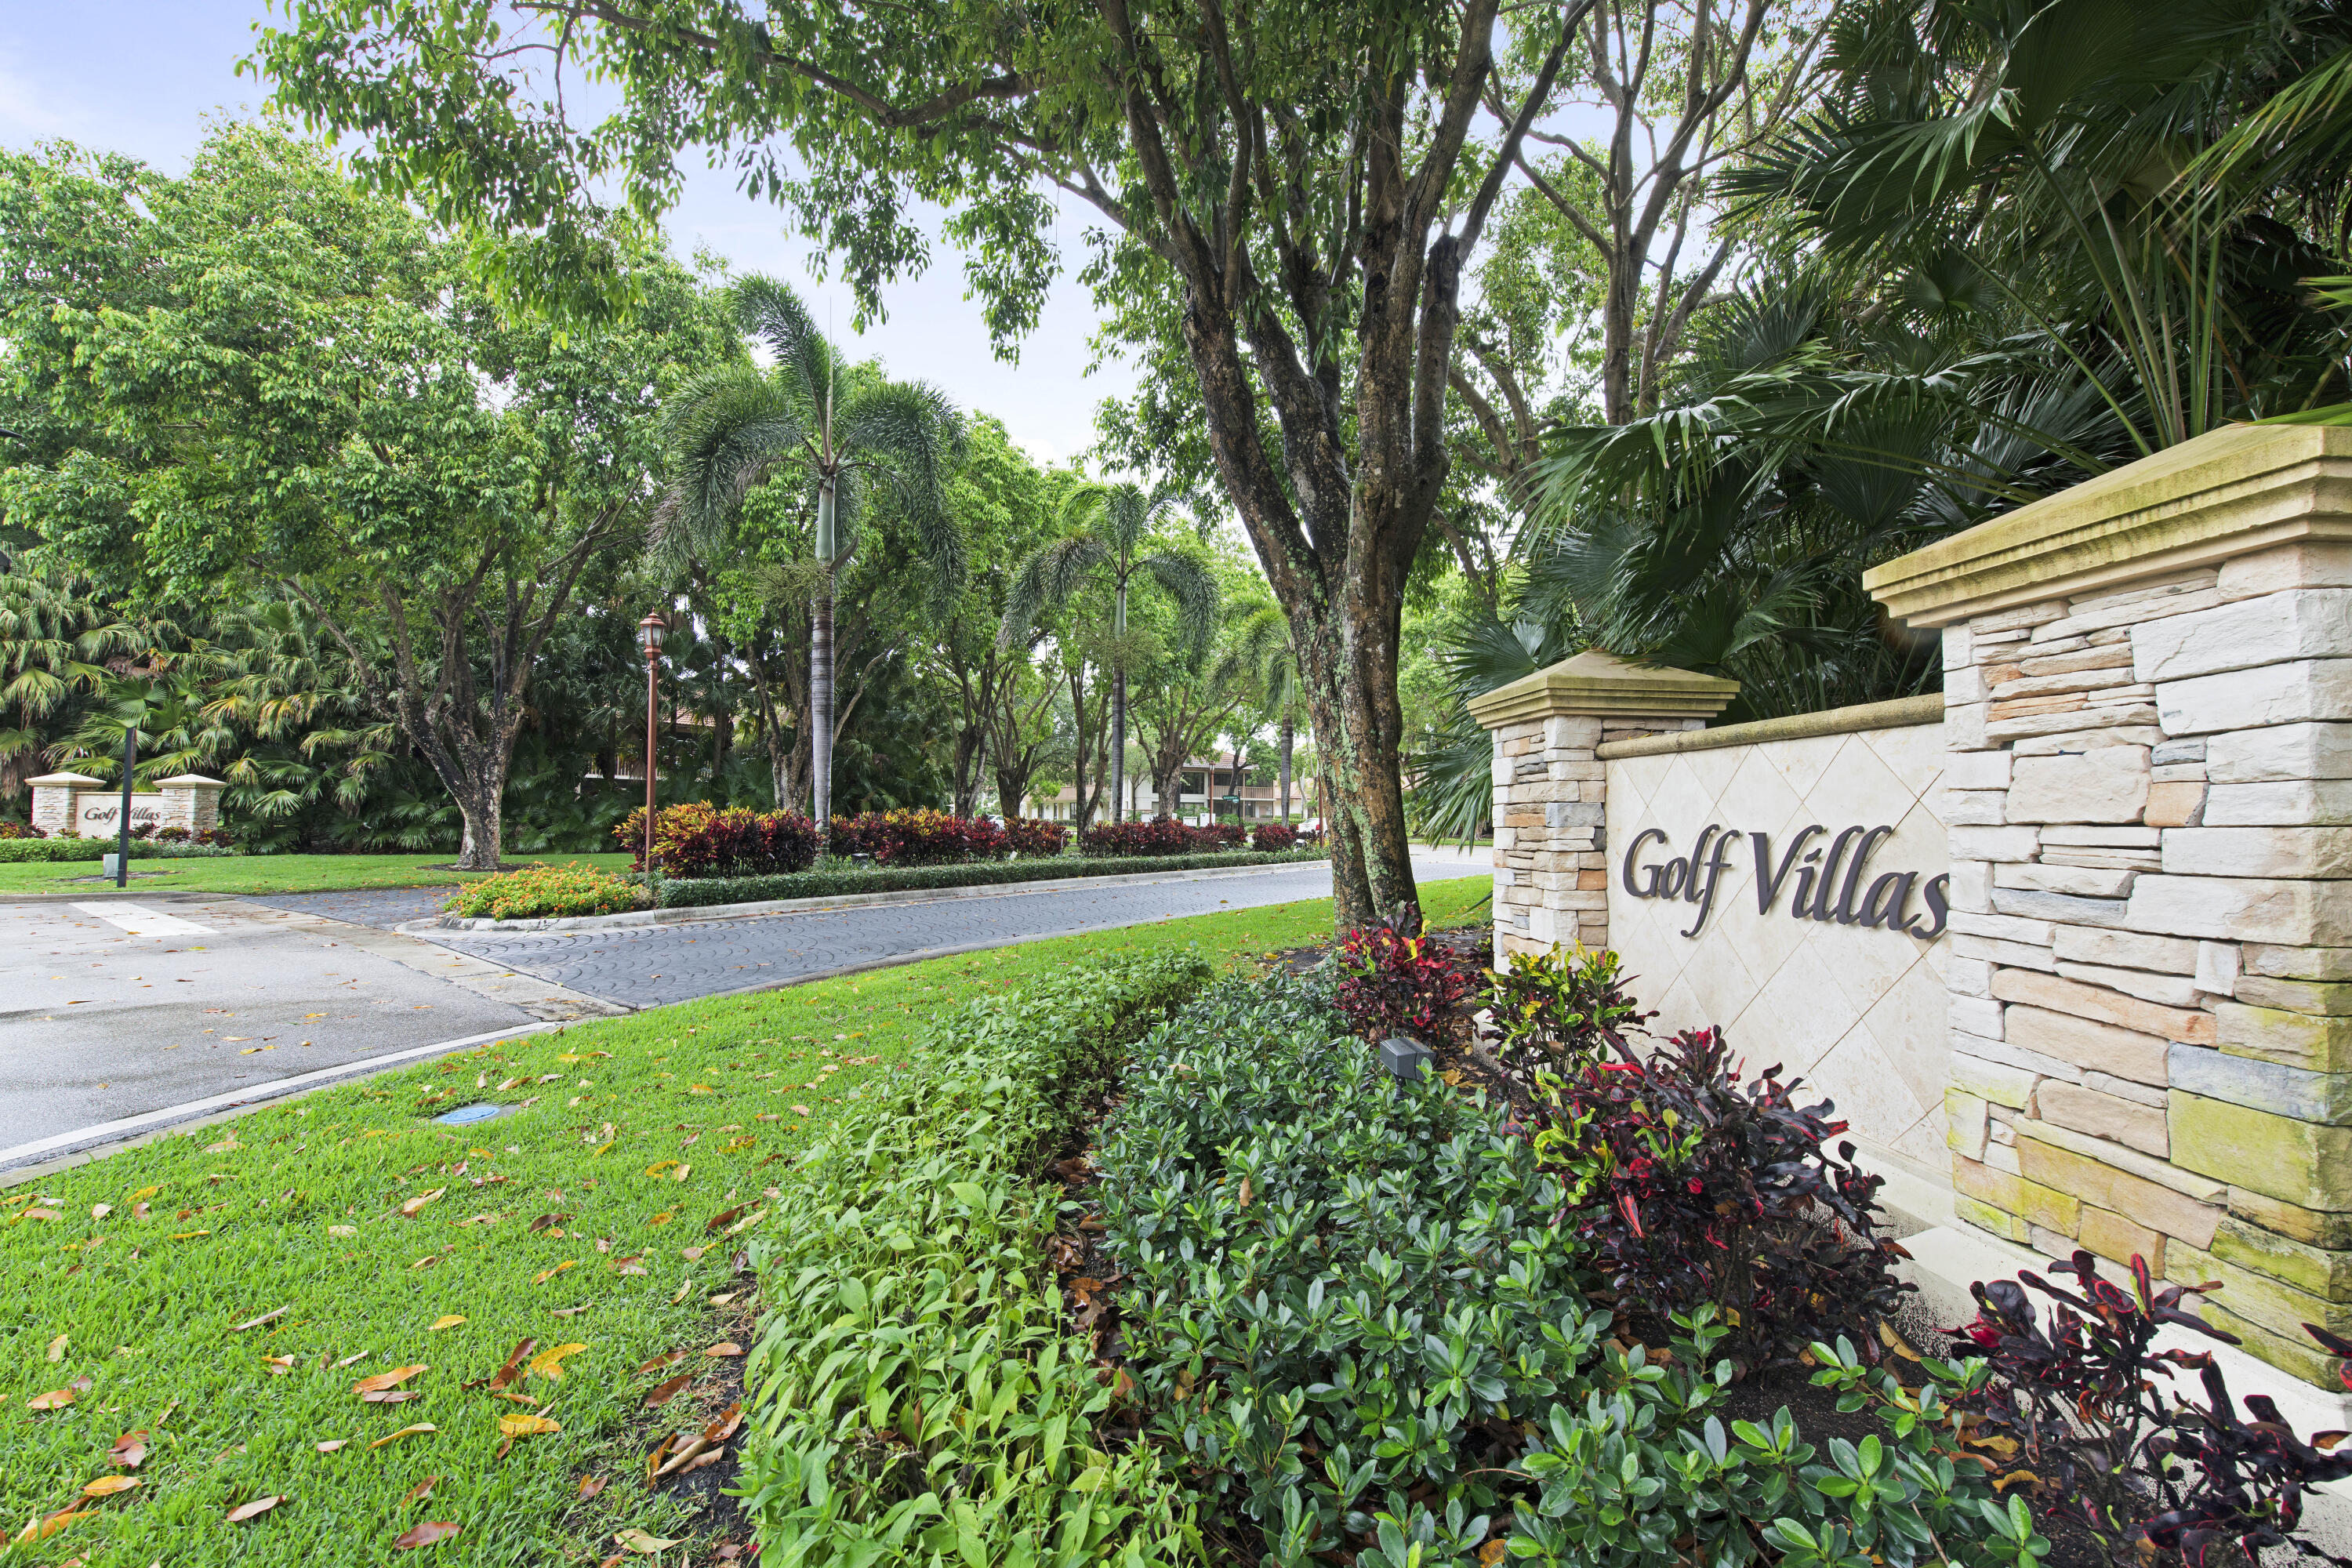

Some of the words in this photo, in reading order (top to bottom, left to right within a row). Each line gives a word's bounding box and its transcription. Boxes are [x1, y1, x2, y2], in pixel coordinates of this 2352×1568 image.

[84, 807, 121, 826] Golf
[1623, 824, 1740, 938] Golf
[1748, 824, 1950, 940] Villas
